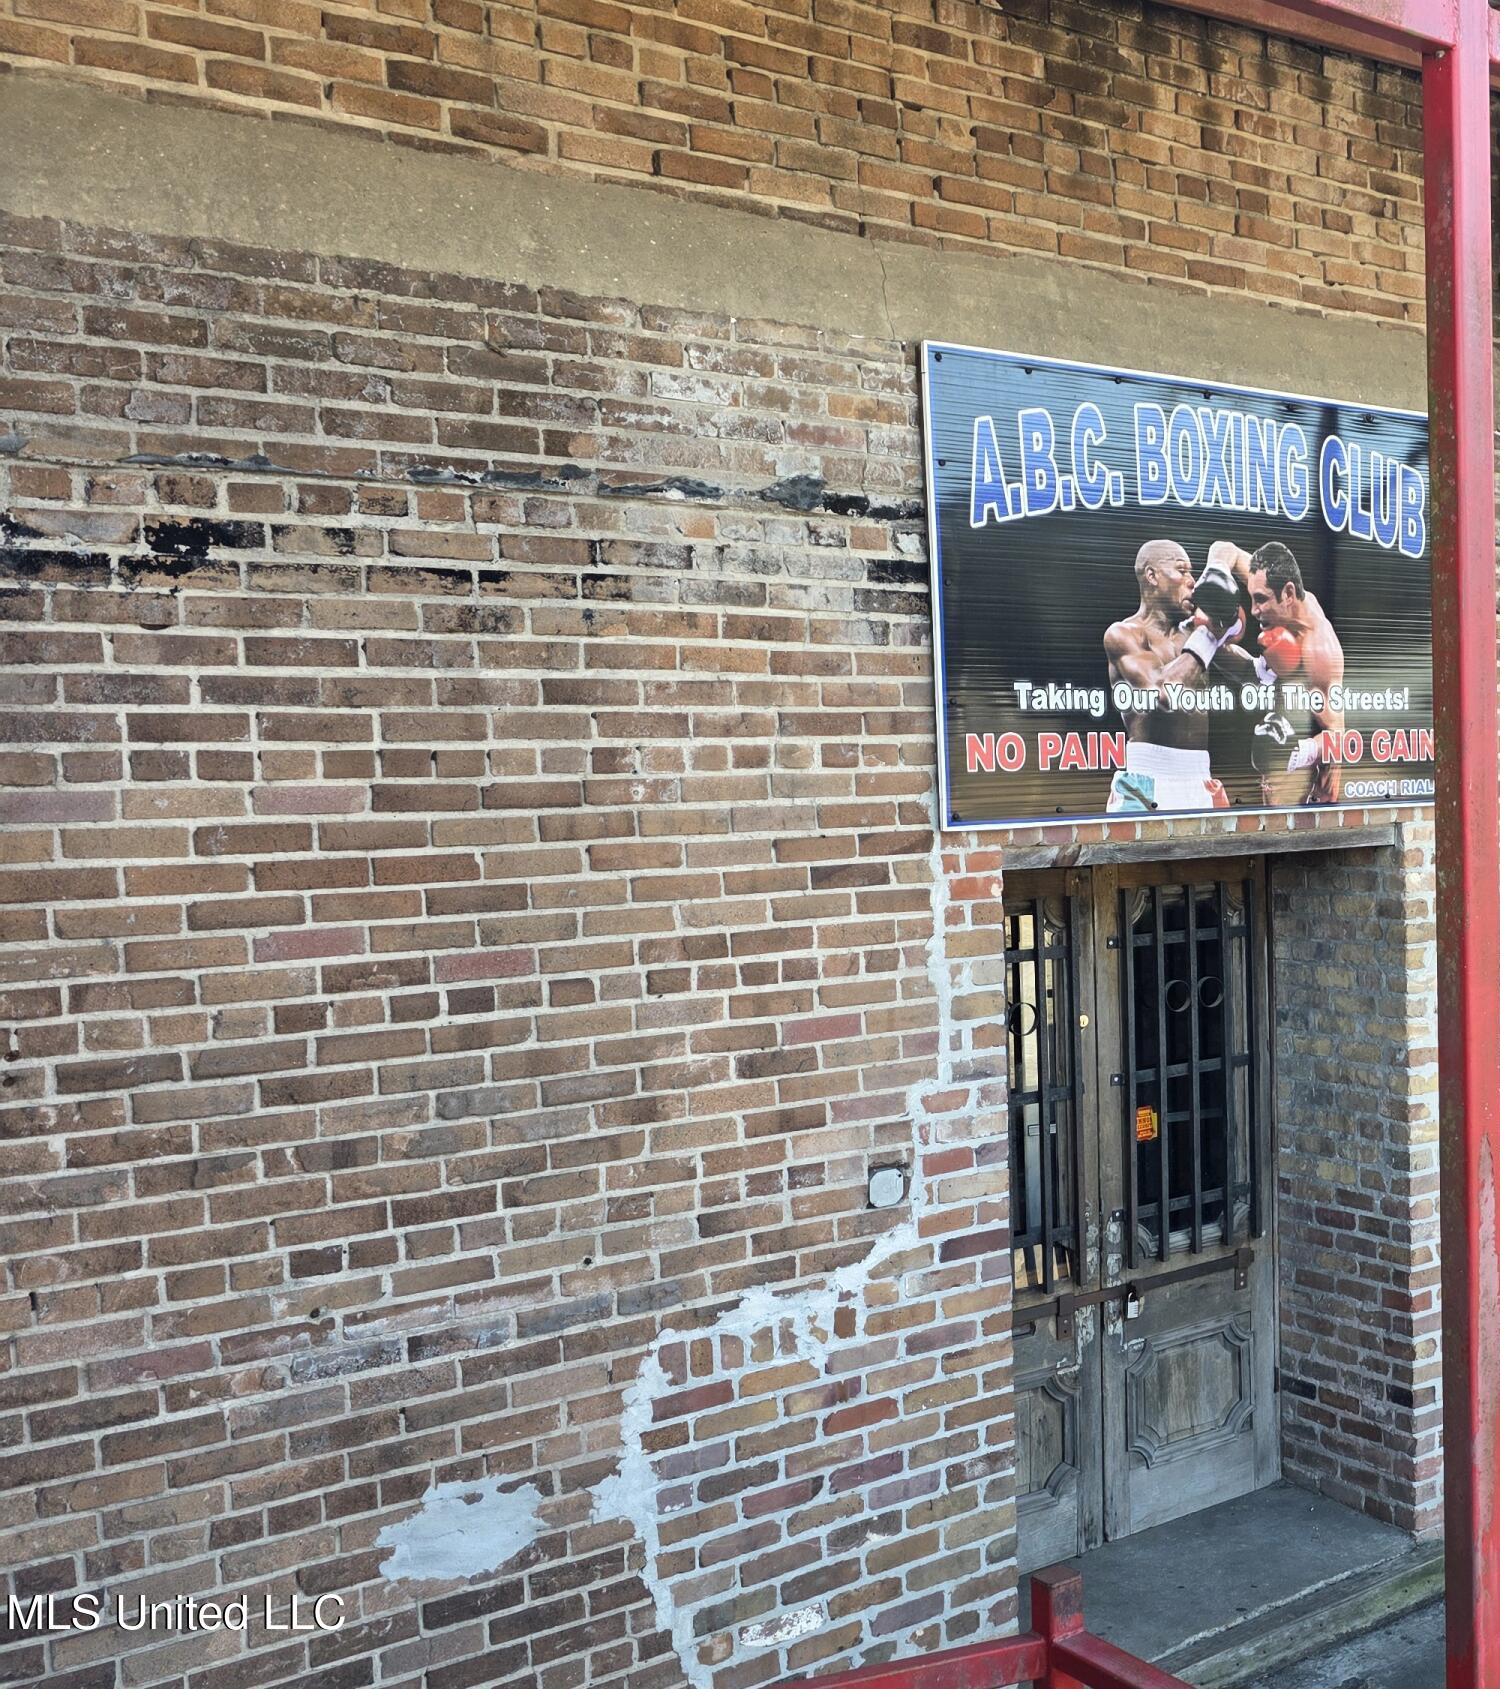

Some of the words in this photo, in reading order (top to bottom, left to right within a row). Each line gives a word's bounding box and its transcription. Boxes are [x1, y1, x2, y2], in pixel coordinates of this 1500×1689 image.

[970, 402, 1124, 528] A.B.C.
[1134, 403, 1309, 521] BOXING
[1320, 435, 1425, 558] CLUB
[1014, 682, 1105, 717] Taking
[1113, 682, 1159, 711] Our
[1164, 683, 1234, 711] Youth
[1241, 684, 1276, 711] Off
[1282, 685, 1324, 712] The
[1329, 684, 1409, 711] Streets!
[966, 732, 1026, 772] NO
[1038, 732, 1127, 771] PAIN
[1322, 729, 1363, 763] NO
[1371, 729, 1434, 762] GAIN
[1344, 780, 1397, 798] COACH
[1400, 779, 1434, 795] RIAL
